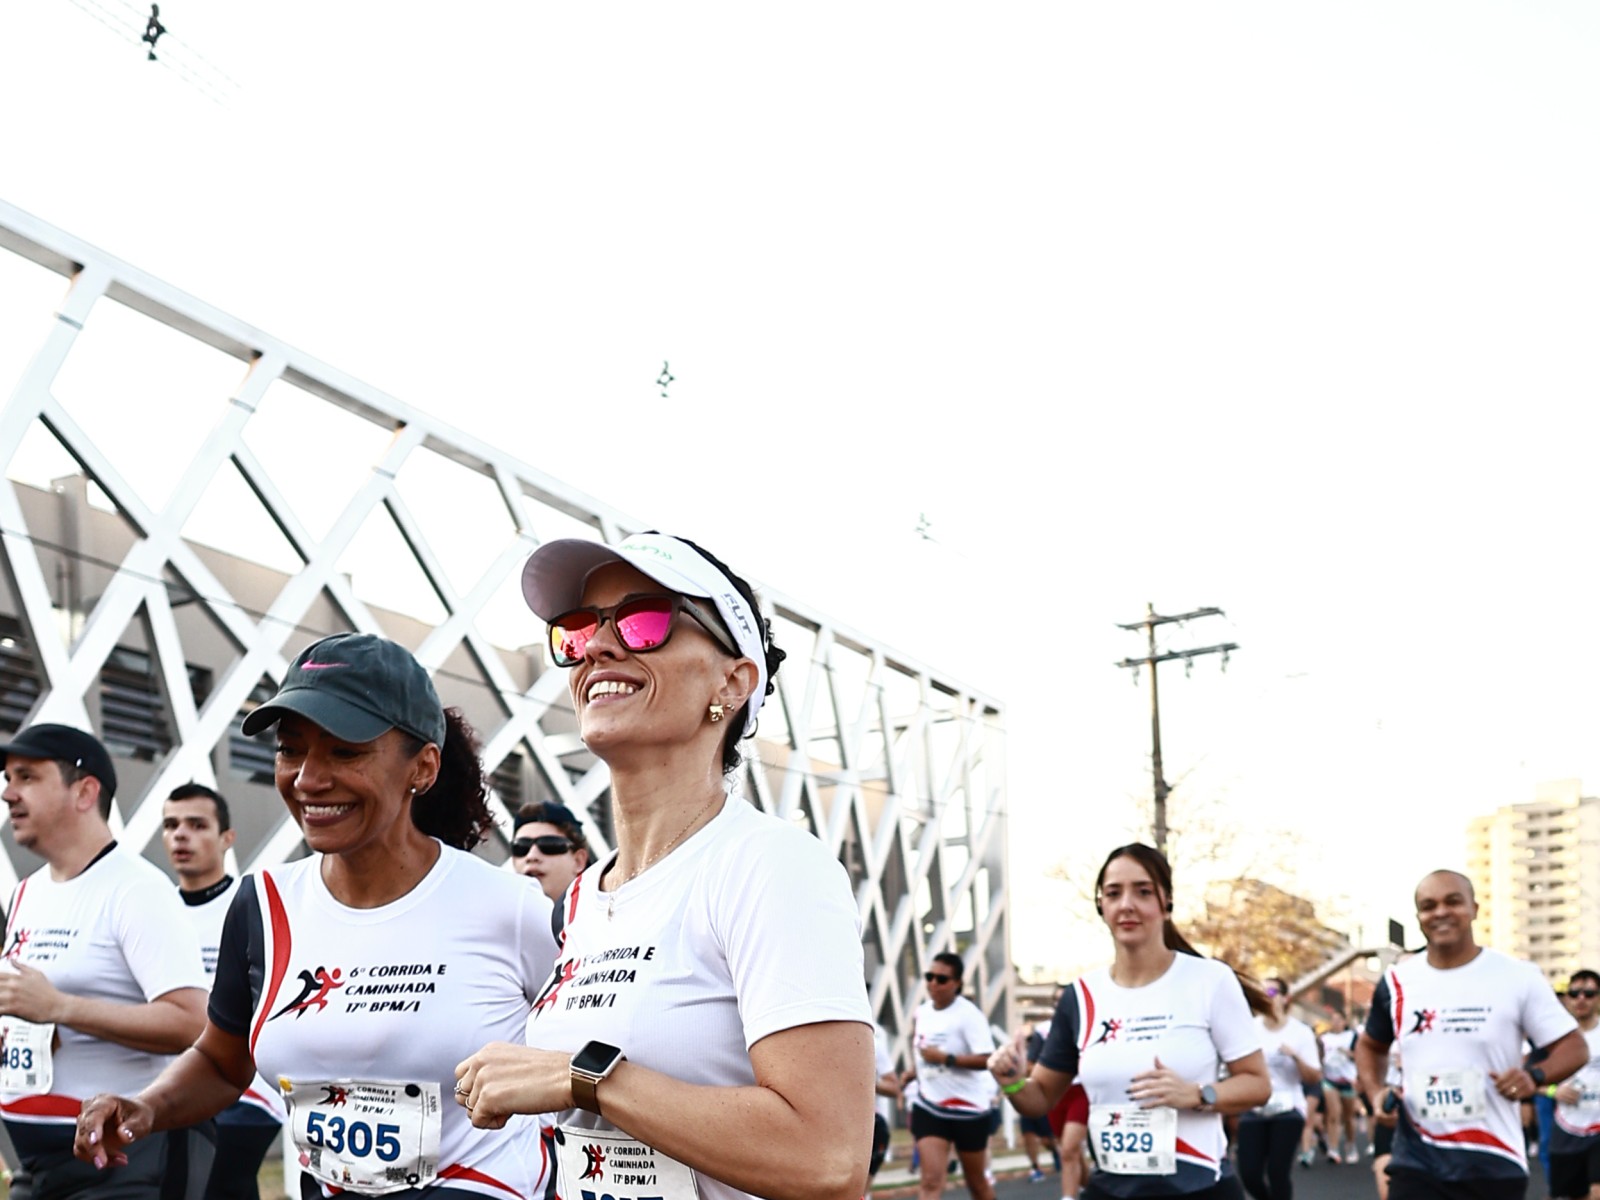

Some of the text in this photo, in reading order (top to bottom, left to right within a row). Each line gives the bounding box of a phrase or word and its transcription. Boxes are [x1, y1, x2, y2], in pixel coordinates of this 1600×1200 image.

[643, 946, 656, 961] E
[369, 965, 432, 977] CORRIDA
[437, 964, 447, 975] E
[571, 969, 636, 988] CAMINHADA
[345, 982, 436, 996] CAMINHADA
[369, 1000, 421, 1012] BPM/I
[578, 993, 617, 1009] BPM/I
[357, 1086, 389, 1095] CORRIDA
[1425, 1088, 1463, 1106] 5115
[362, 1105, 394, 1115] BPM/I
[306, 1111, 401, 1162] 5305
[1101, 1132, 1153, 1153] 5329
[613, 1147, 647, 1156] CORRIDA
[609, 1160, 655, 1169] CAMINHADA
[624, 1174, 656, 1185] BPM/I
